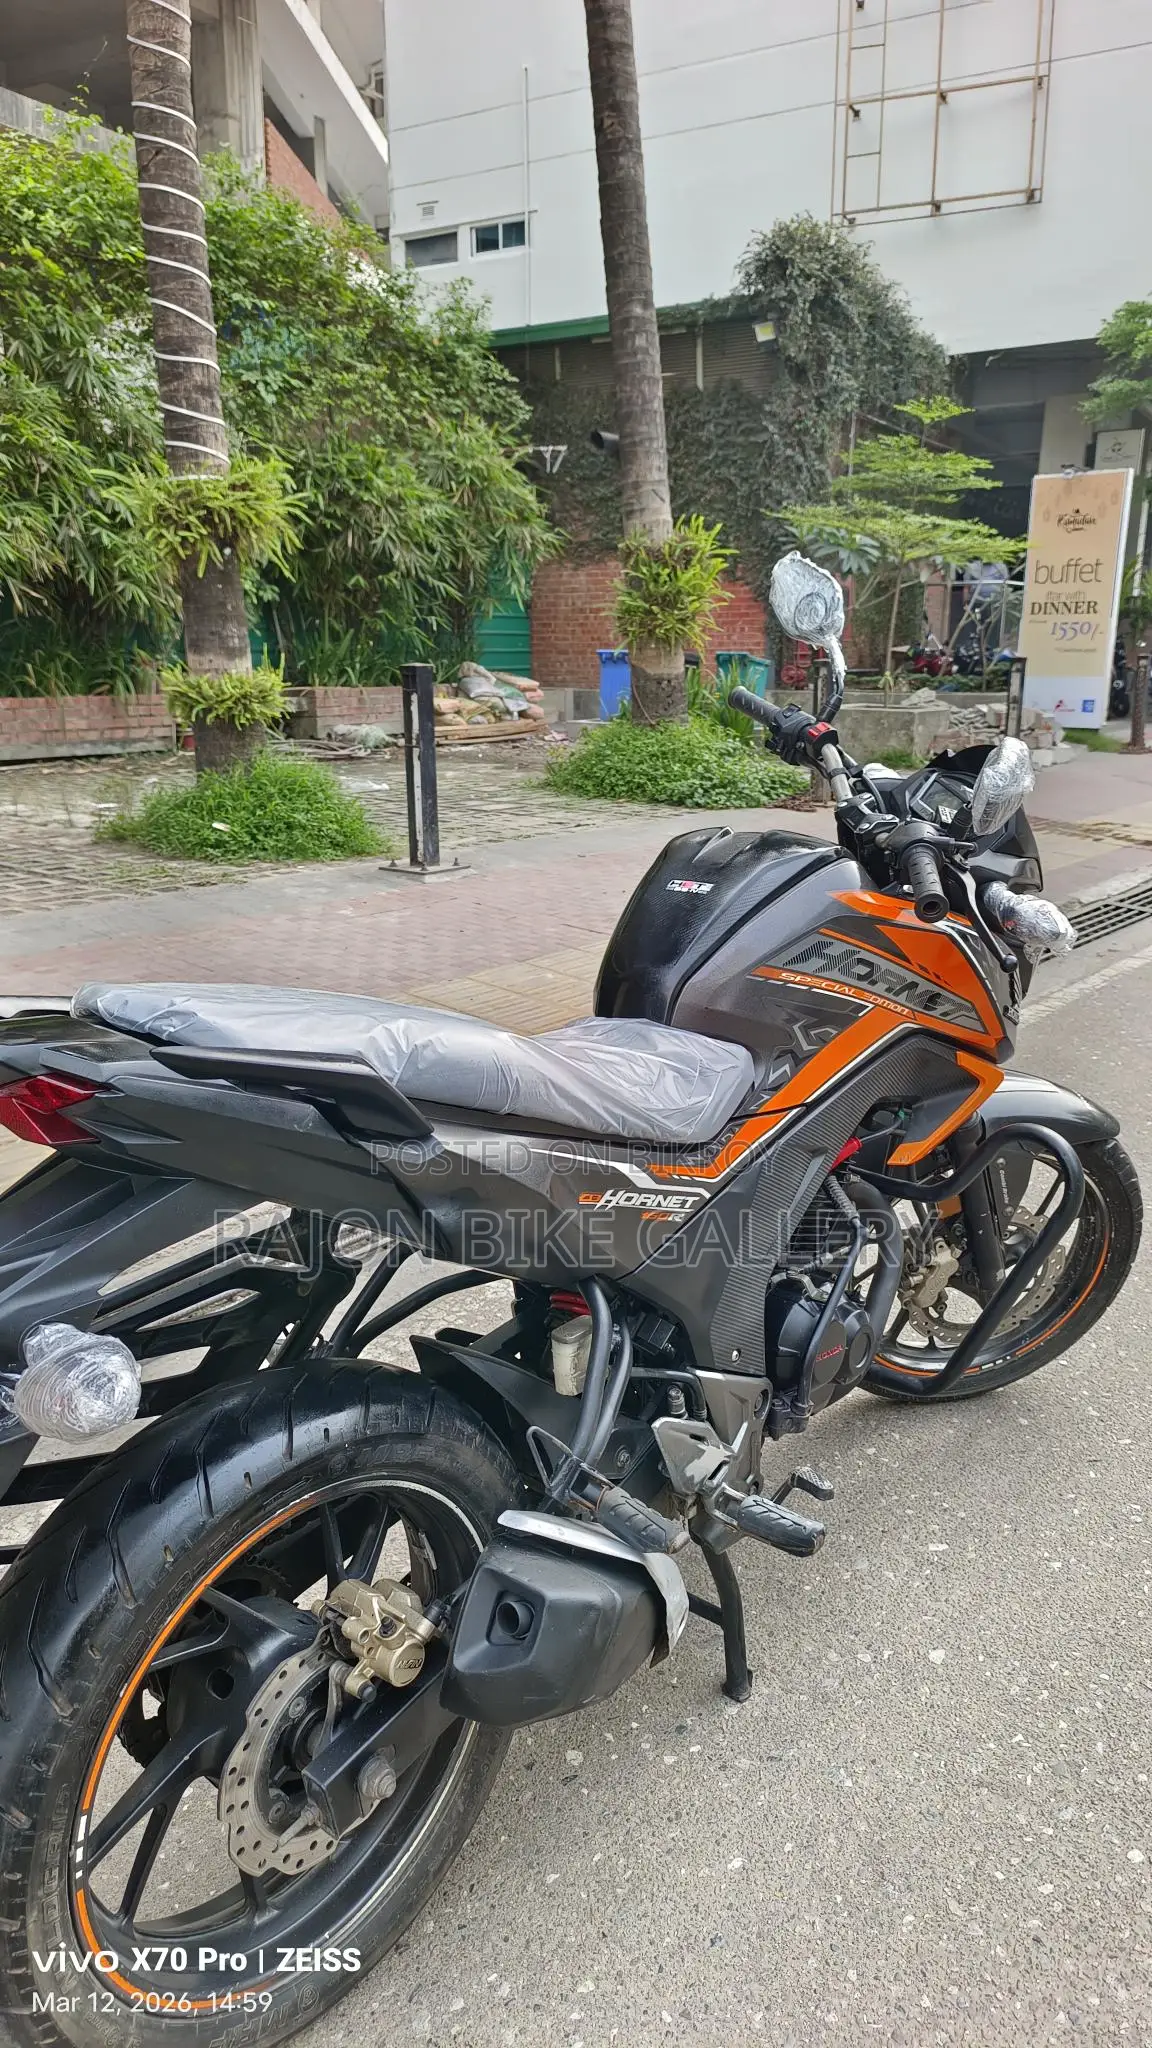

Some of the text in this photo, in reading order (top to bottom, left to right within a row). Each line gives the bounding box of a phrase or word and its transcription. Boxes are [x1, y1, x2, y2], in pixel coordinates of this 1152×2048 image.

[1034, 557, 1104, 584] buffet
[1030, 600, 1098, 616] DINNER
[1050, 621, 1104, 641] 1550/-
[781, 972, 858, 998] SPECIAL
[782, 940, 975, 1018] HORNET
[594, 1189, 700, 1212] HORNET
